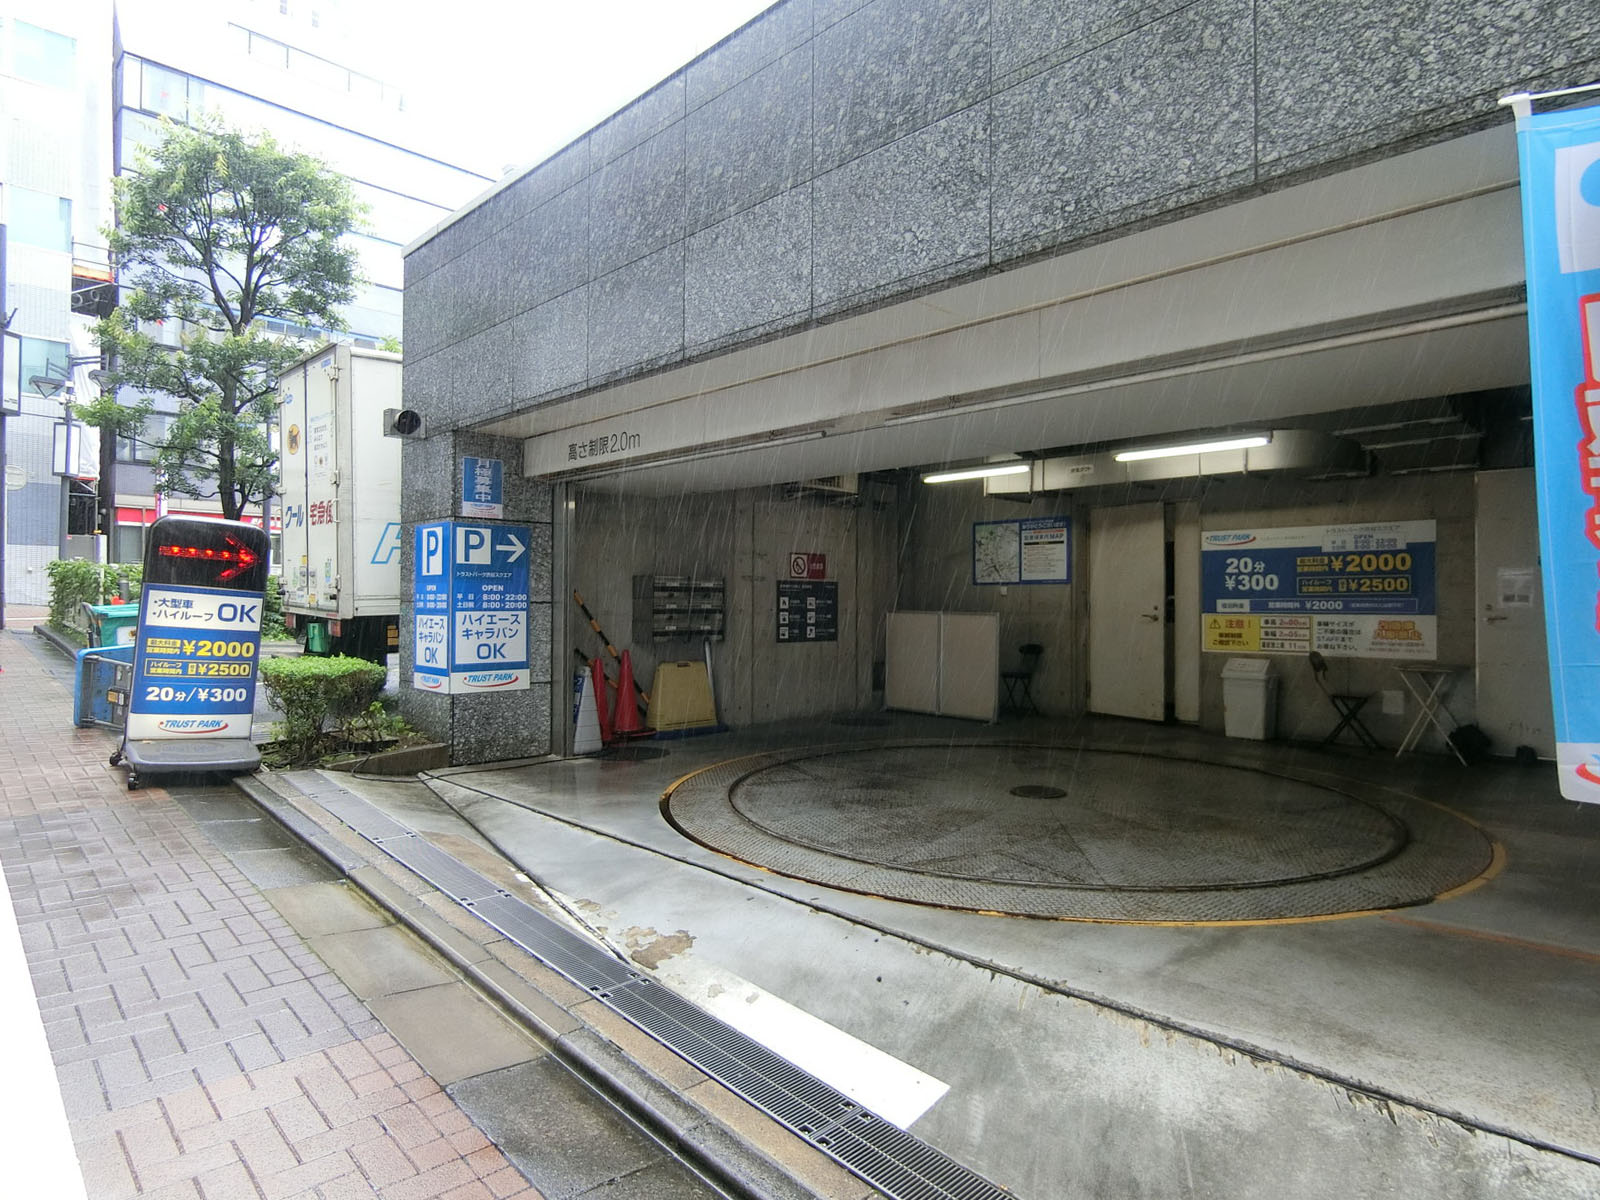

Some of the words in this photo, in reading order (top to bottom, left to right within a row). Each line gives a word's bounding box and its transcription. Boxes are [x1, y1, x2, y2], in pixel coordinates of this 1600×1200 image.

[285, 503, 304, 529] クール
[426, 529, 439, 574] P
[463, 529, 485, 563] P
[1225, 557, 1265, 574] 20分
[1331, 552, 1413, 572] ¥2000
[481, 584, 505, 592] OPEN
[1224, 574, 1279, 591] ¥300
[1348, 578, 1409, 592] ¥2500
[1304, 600, 1343, 610] ¥2000
[217, 602, 258, 624] OK
[461, 614, 521, 626] ハイエース
[418, 617, 446, 630] ハイエース
[418, 632, 445, 645] キャラバン
[461, 627, 519, 640] キャラバン
[182, 639, 255, 658] ¥2000
[424, 646, 439, 665] OK
[476, 642, 507, 660] OK
[197, 663, 250, 676] ¥2500
[467, 673, 493, 683] TRUST
[492, 672, 514, 681] PARK
[164, 719, 197, 728] TRUST
[196, 719, 223, 728] PARK
